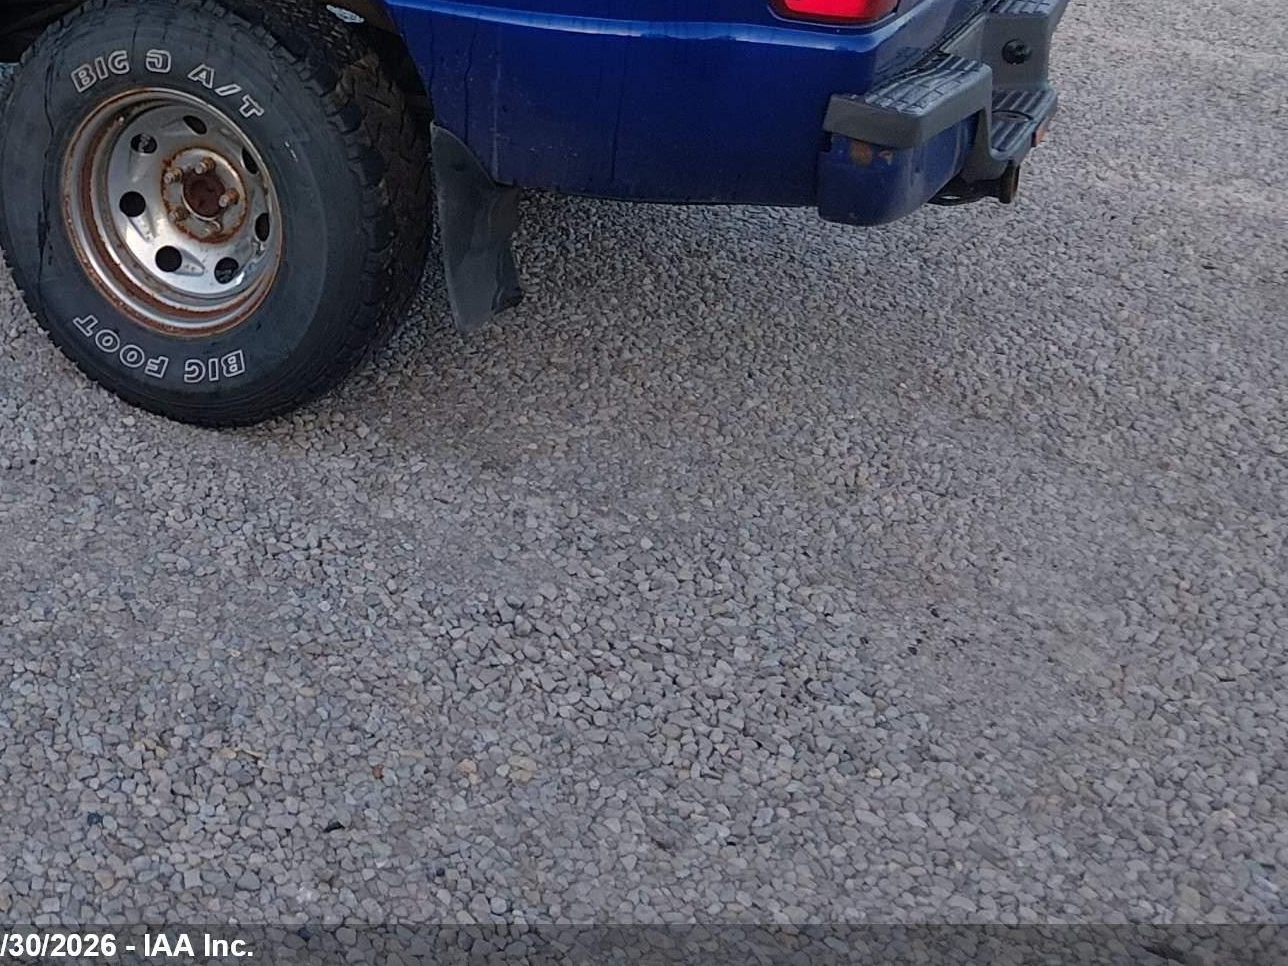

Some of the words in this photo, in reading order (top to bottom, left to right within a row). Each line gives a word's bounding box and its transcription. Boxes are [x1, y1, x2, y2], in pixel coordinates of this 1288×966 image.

[71, 50, 130, 93] BIG
[188, 64, 265, 118] A/T
[72, 314, 169, 378] FOOT
[183, 349, 246, 384] BIG
